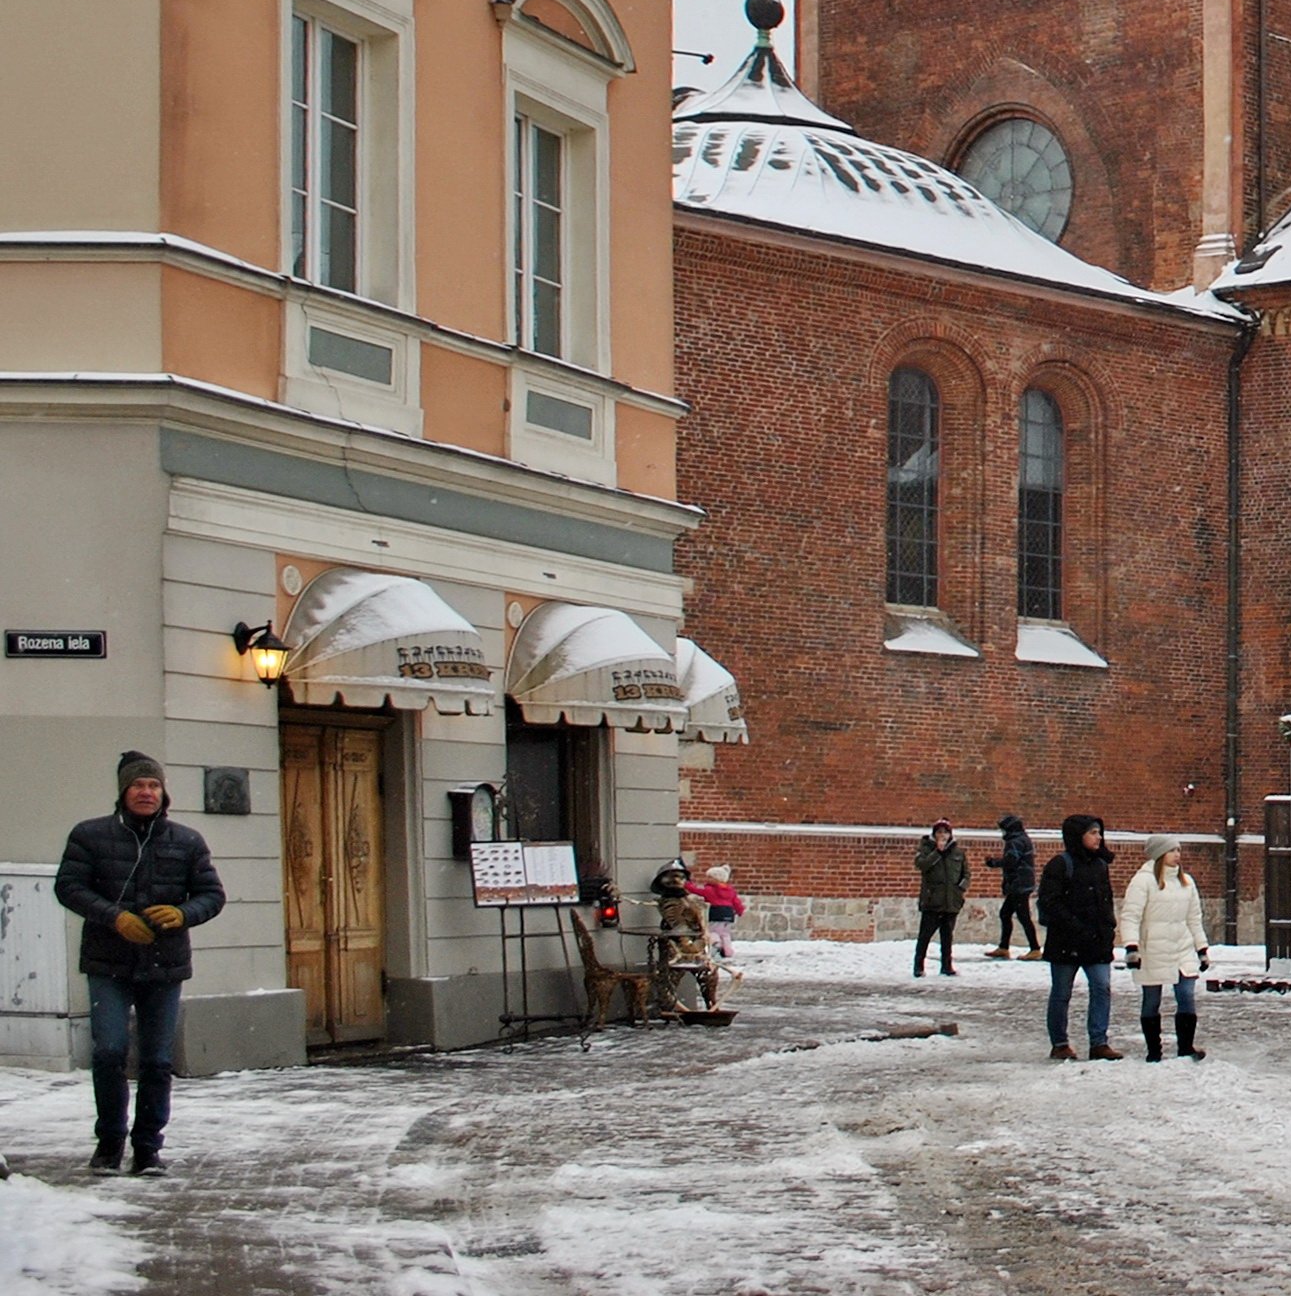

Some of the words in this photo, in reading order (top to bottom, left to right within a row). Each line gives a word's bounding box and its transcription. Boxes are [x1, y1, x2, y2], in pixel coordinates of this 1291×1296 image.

[18, 635, 64, 651] Rozena
[67, 635, 91, 651] iela
[398, 661, 434, 679] 13
[613, 684, 642, 701] 13
